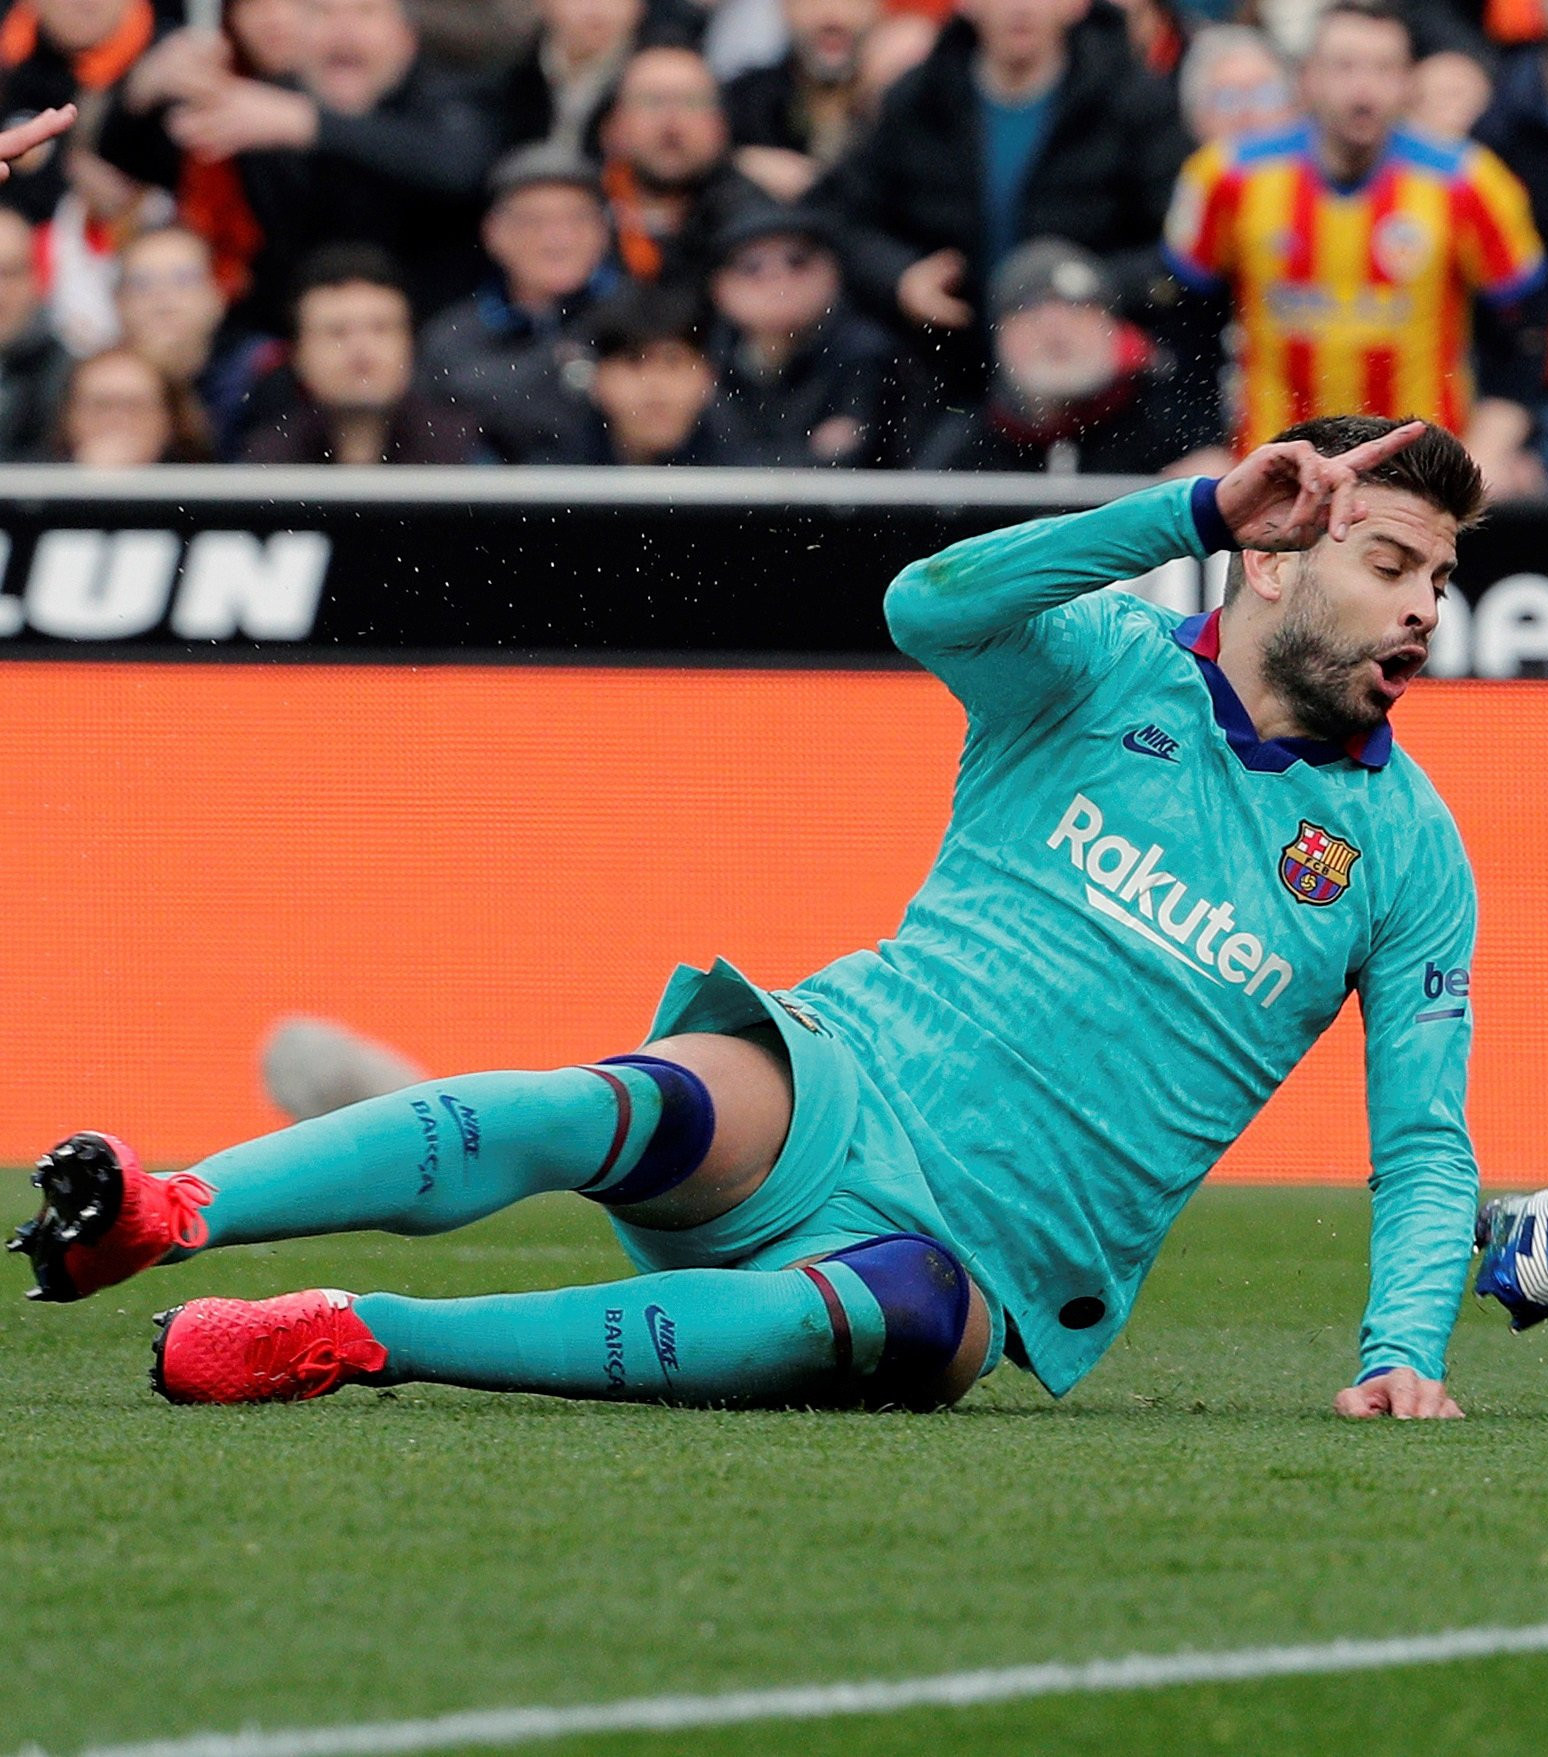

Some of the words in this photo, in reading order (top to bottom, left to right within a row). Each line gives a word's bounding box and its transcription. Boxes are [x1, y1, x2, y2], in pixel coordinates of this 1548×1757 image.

[1137, 723, 1180, 758] NIKE
[1046, 793, 1293, 1009] Rakuten
[603, 1309, 626, 1391] BARÇA
[659, 1316, 680, 1370] NIKE
